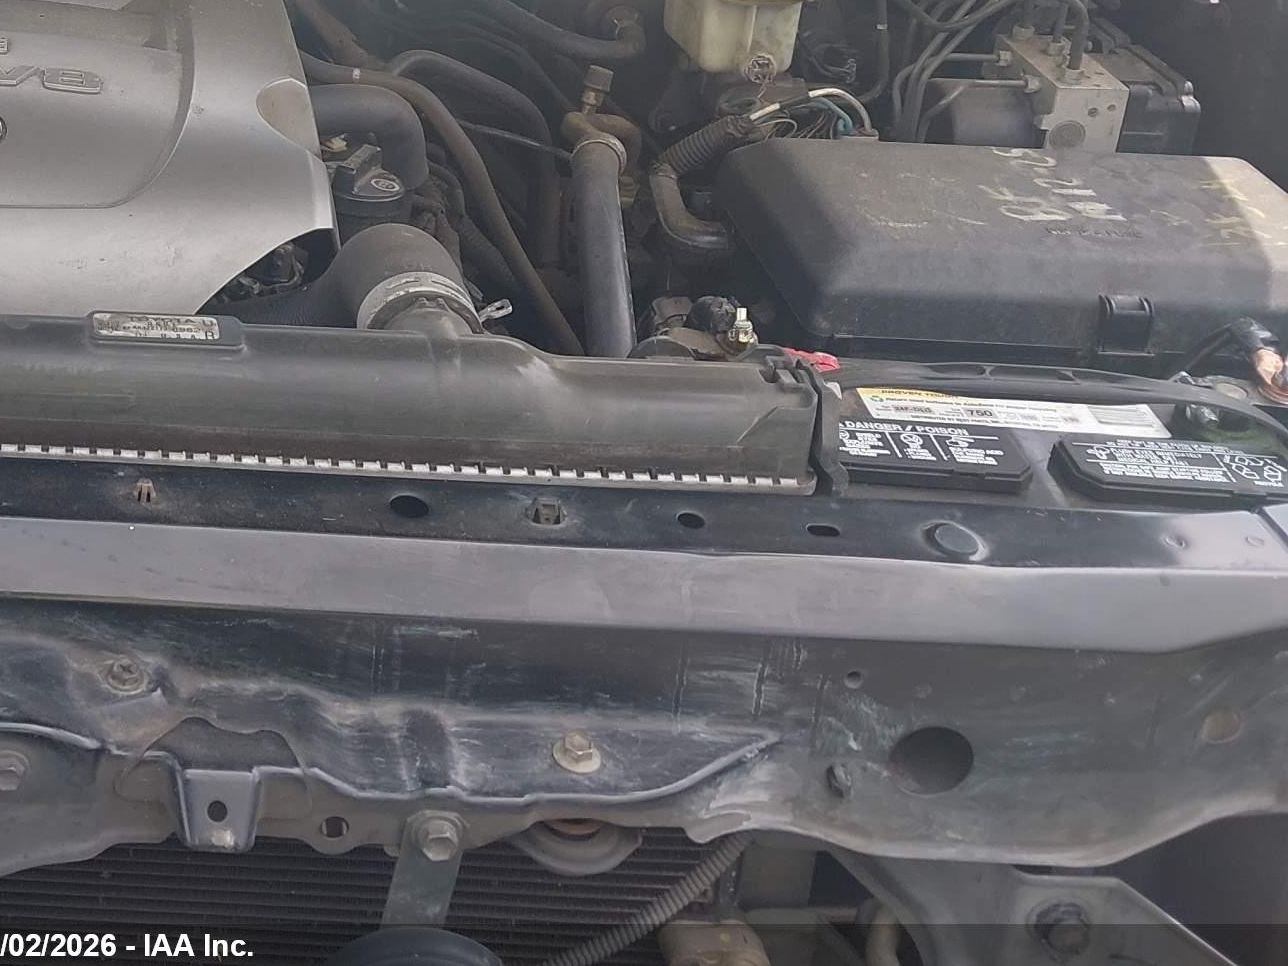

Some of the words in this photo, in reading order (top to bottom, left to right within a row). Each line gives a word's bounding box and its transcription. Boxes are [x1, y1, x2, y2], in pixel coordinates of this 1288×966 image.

[967, 408, 993, 417] 750
[844, 420, 903, 432] DANGER
[916, 425, 969, 436] POISON
